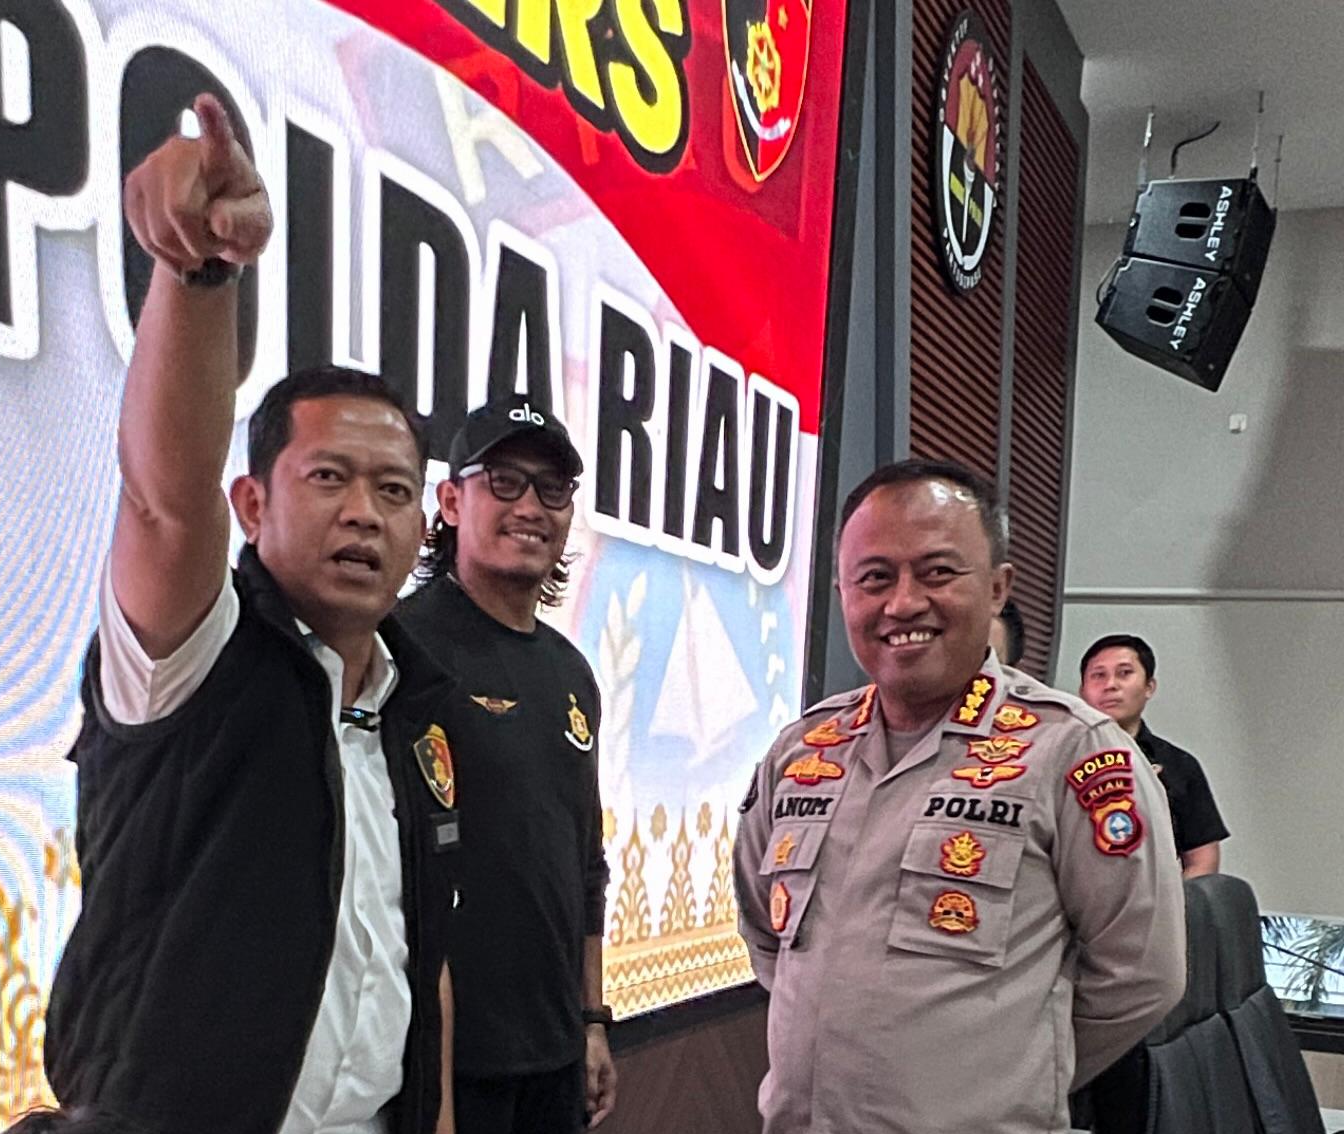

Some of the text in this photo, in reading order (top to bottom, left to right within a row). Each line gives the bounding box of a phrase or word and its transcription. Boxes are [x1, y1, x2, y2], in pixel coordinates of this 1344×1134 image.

[1205, 186, 1233, 262] ASHLEY
[1170, 277, 1207, 350] ASHLEY
[509, 403, 545, 426] alo
[595, 300, 794, 571] RIAU
[1073, 753, 1126, 783] POLDA
[1088, 780, 1125, 799] RIAU
[924, 796, 1024, 828] POLRI
